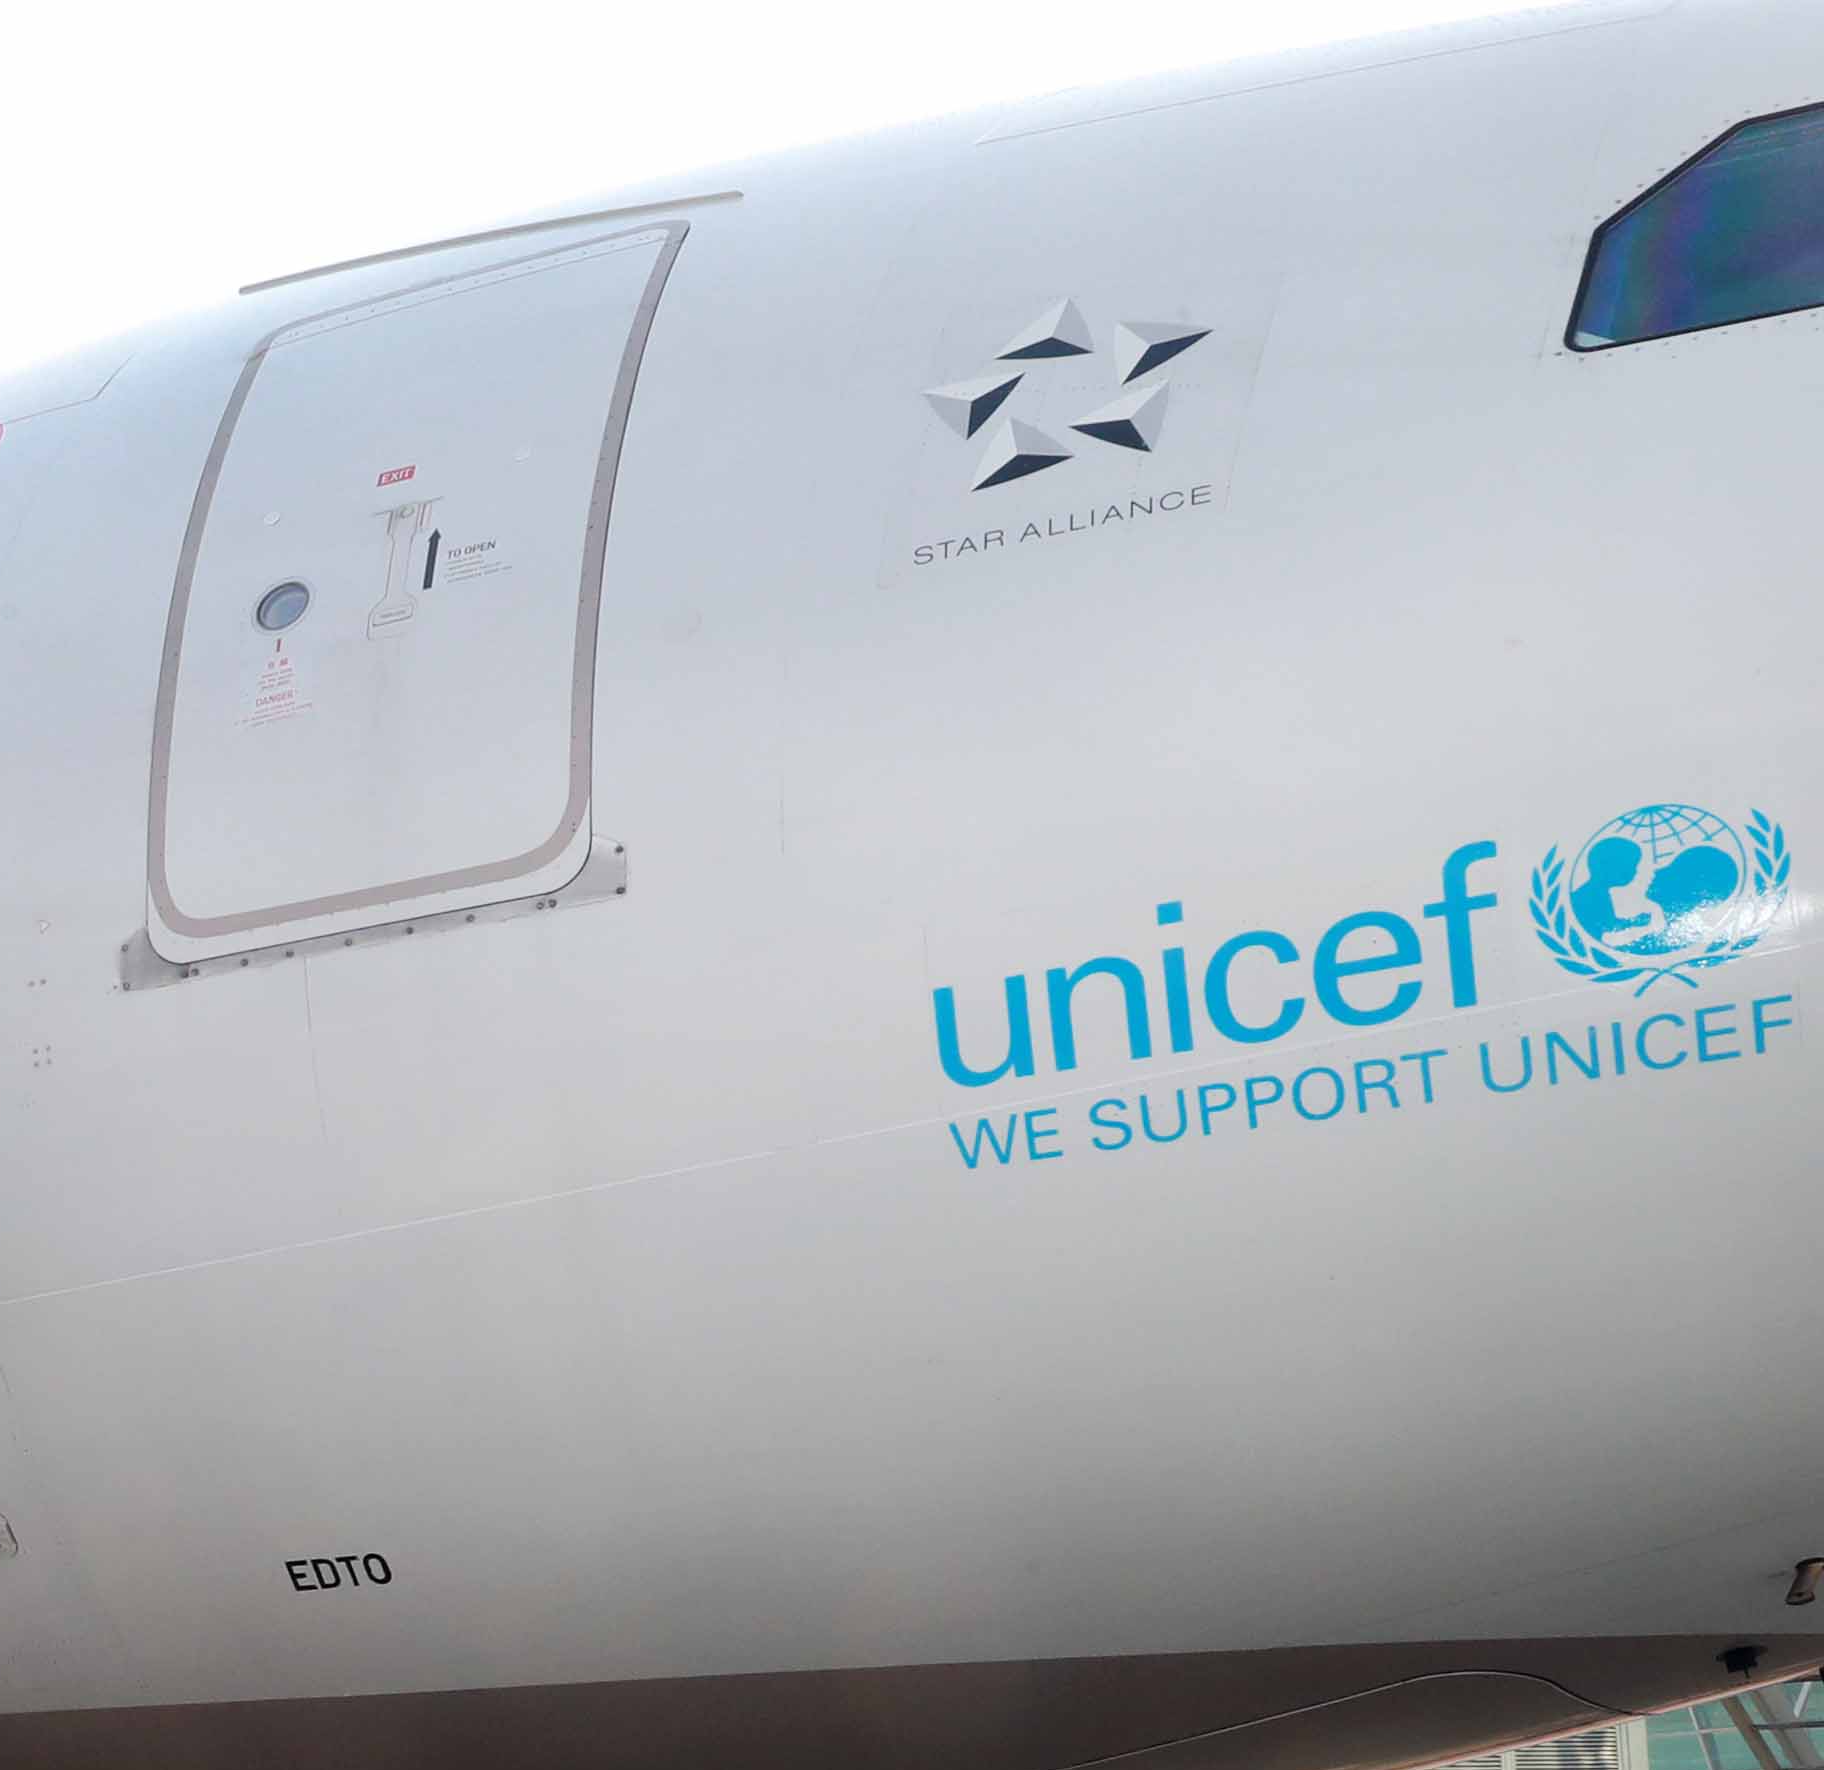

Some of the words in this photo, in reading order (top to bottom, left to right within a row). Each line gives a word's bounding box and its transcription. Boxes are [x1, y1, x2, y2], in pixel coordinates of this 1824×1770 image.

[381, 468, 411, 484] EXIT
[447, 549, 462, 560] TO
[464, 539, 497, 555] OPEN
[913, 529, 1005, 566] STAR
[1019, 484, 1212, 543] ALLIANCE
[932, 840, 1498, 1088] unicef
[948, 1107, 1064, 1169] WE
[1088, 1048, 1448, 1151] SUPPORT
[1479, 994, 1793, 1093] UNICEF
[284, 1552, 393, 1592] EDTO
